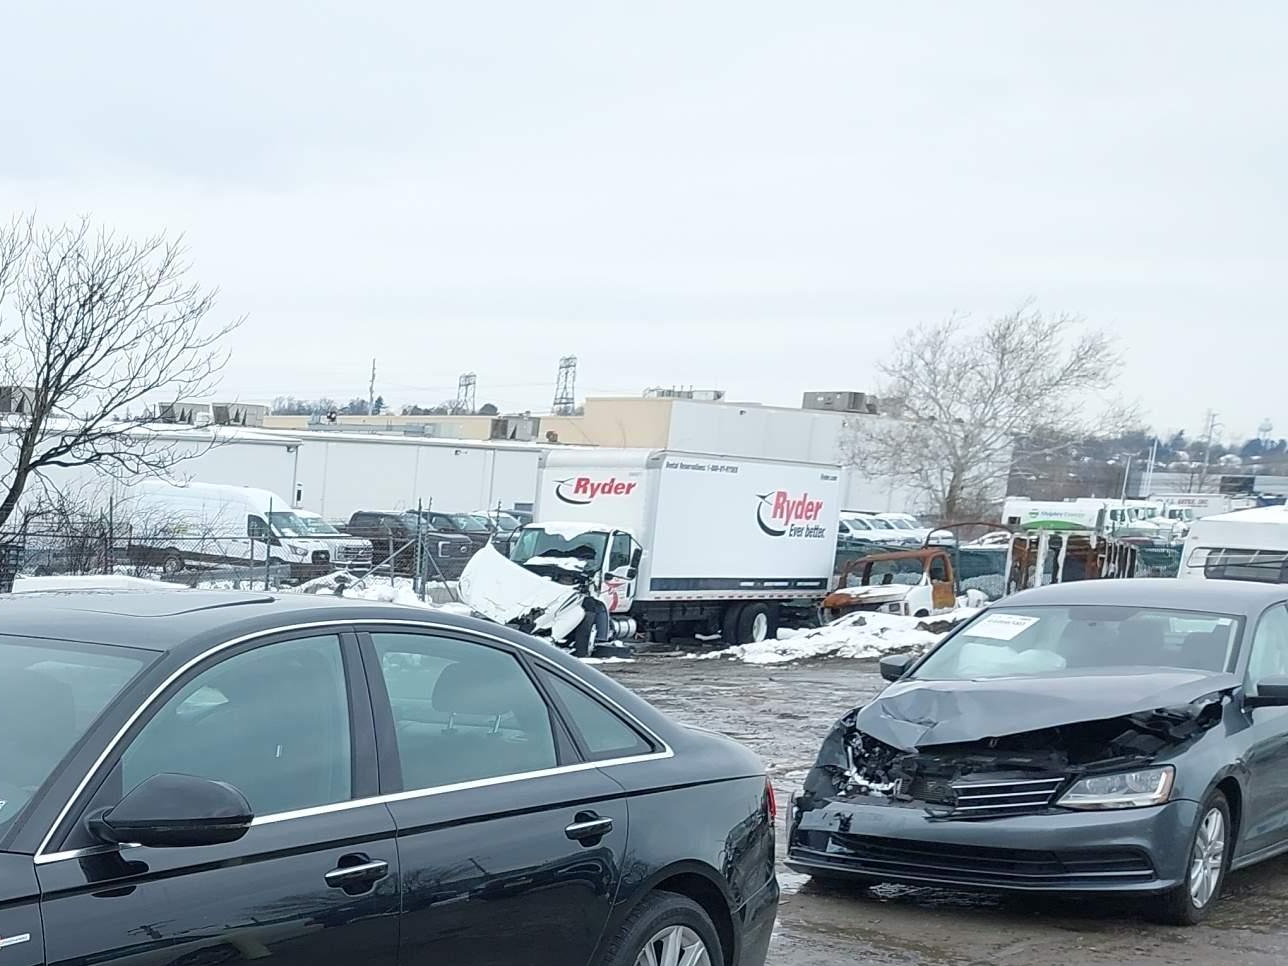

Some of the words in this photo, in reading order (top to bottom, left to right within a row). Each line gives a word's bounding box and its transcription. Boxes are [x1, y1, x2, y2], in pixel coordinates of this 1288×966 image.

[574, 478, 636, 499] Ryder
[772, 491, 823, 526] Ryder
[789, 524, 805, 537] Ever
